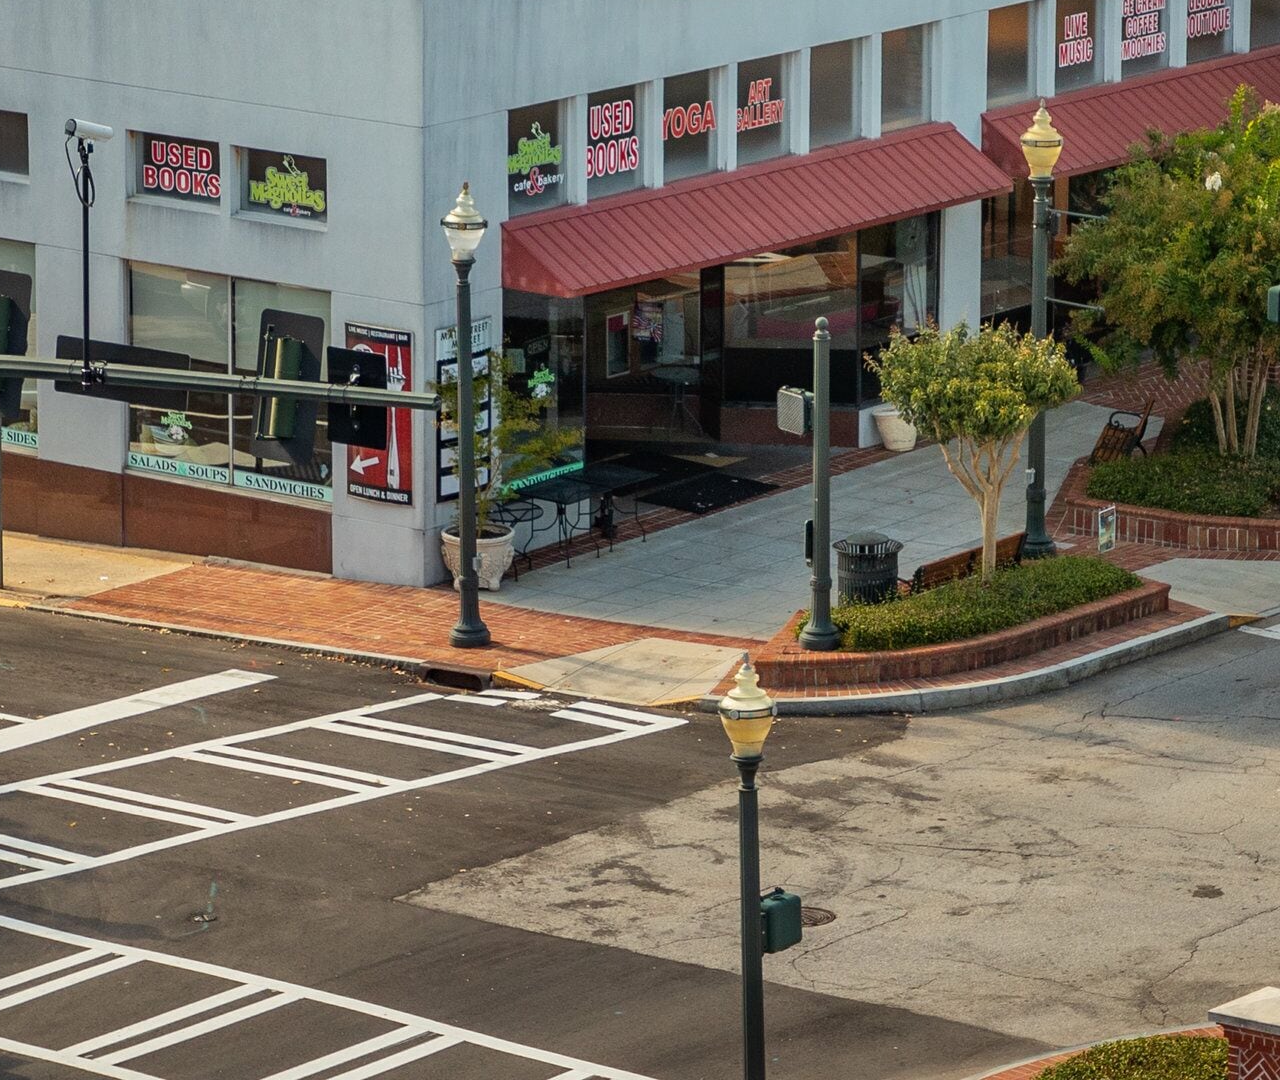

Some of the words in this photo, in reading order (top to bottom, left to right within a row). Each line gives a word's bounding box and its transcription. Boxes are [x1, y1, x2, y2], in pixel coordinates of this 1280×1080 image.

[1064, 11, 1088, 41] LIVE
[1126, 12, 1159, 37] COFFEE
[1187, 7, 1231, 39] OUTIQUE
[1058, 36, 1093, 68] MUSIC
[748, 77, 773, 106] ART
[590, 99, 634, 140] USED
[662, 100, 716, 141] YOGA
[151, 140, 212, 171] USED
[586, 135, 639, 179] BOOKS
[143, 164, 222, 198] BOOKS
[264, 166, 309, 189] Sweet
[249, 179, 326, 213] Magnolias
[6, 431, 37, 446] SIDES
[130, 453, 177, 473] SALADS
[188, 465, 227, 481] SOUPS
[245, 475, 325, 500] SANDWICHES
[350, 483, 363, 495] OPEN
[363, 487, 380, 498] LUNCH
[386, 491, 409, 502] DINNER
